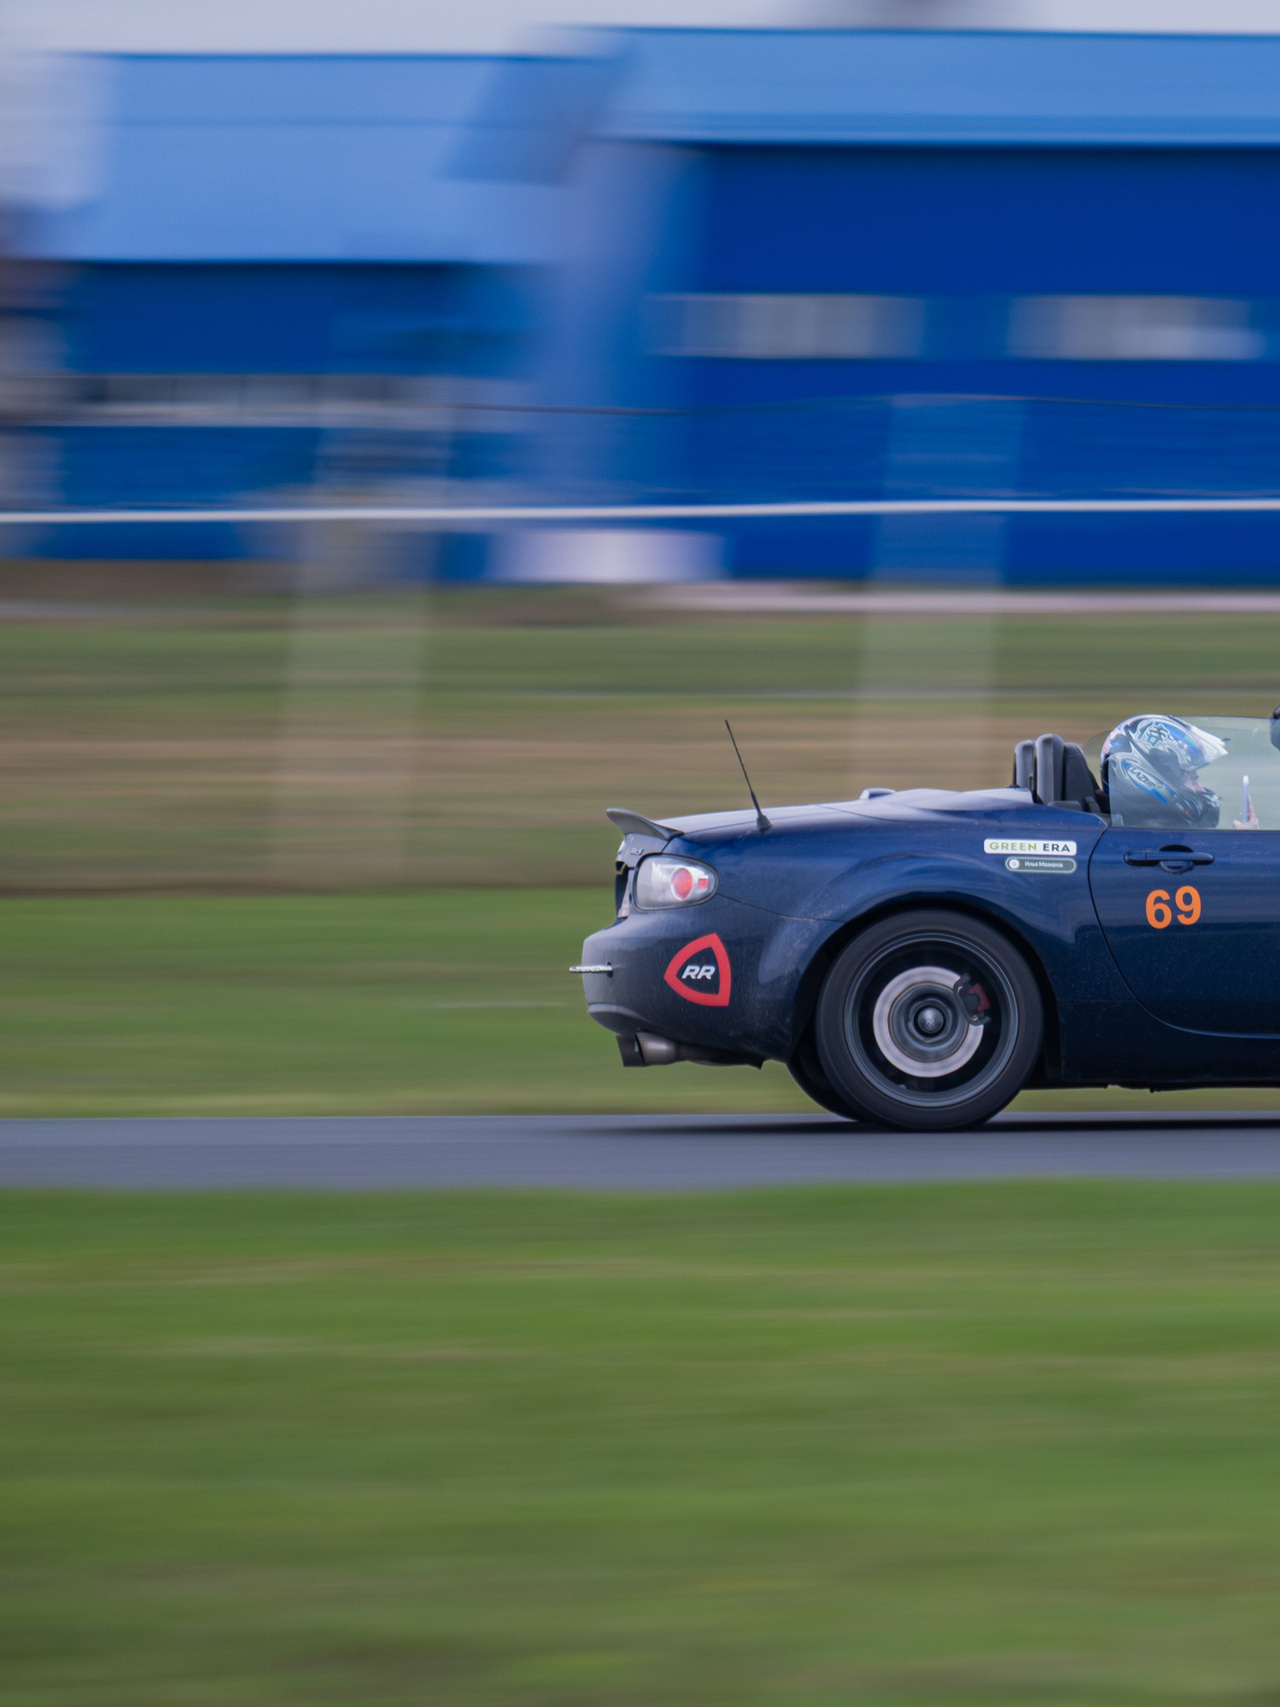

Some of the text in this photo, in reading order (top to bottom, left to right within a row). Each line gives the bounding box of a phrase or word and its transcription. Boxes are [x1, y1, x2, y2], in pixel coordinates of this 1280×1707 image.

[989, 841, 1071, 852] GREEN ERA
[1145, 885, 1202, 930] 69
[681, 964, 716, 979] RR
